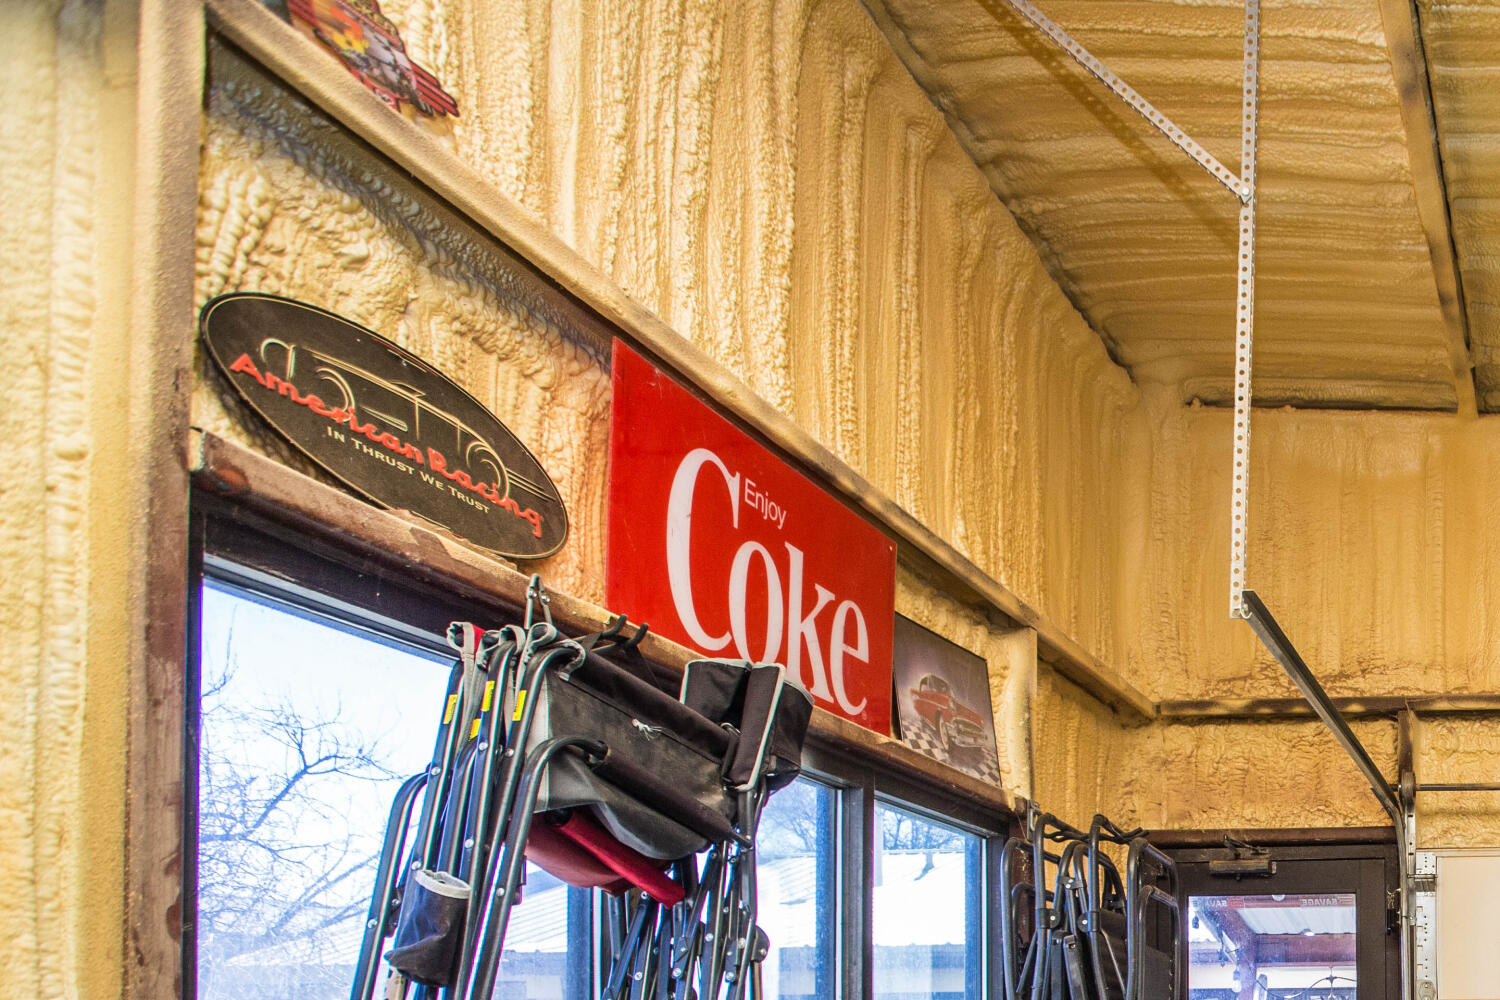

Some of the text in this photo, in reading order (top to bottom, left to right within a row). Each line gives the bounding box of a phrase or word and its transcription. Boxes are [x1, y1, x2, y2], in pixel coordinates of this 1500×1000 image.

[229, 352, 544, 538] American Racing
[326, 425, 490, 514] IN THRUST WE TRUST
[744, 477, 788, 530] Enjoy
[666, 447, 870, 717] Coke
